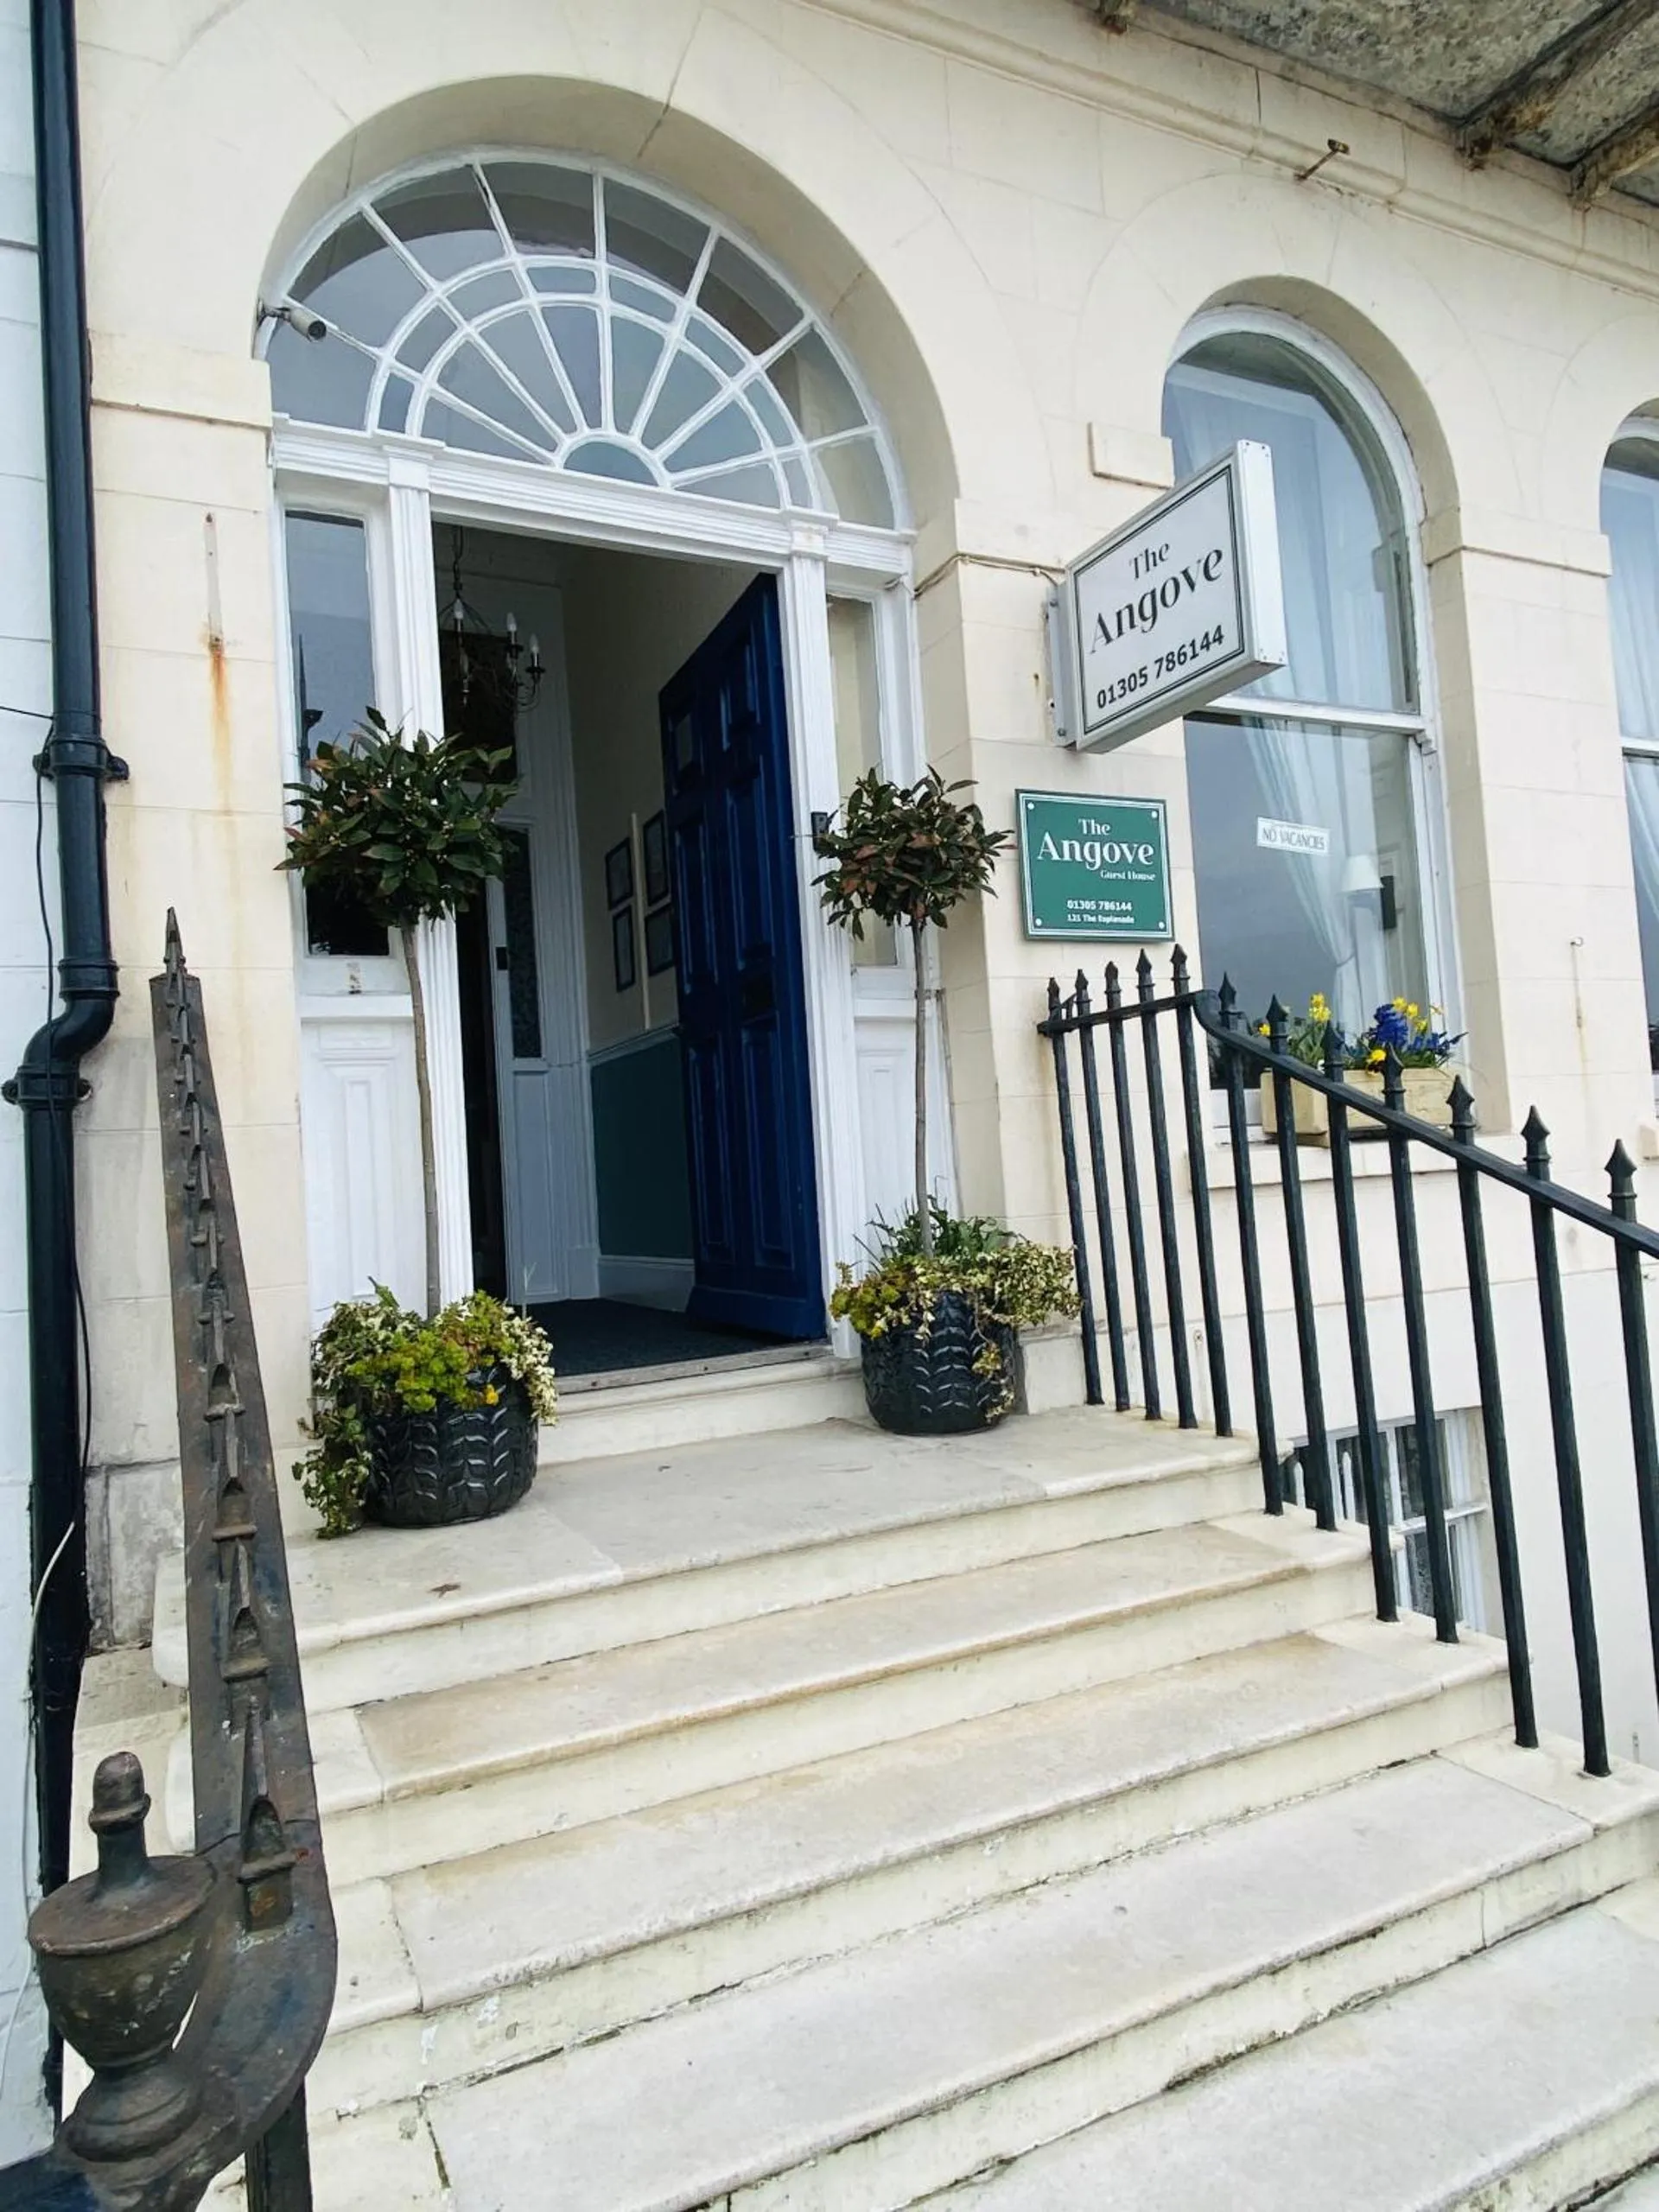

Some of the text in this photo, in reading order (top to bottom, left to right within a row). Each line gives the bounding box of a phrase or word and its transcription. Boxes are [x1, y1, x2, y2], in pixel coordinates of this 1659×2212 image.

[1129, 543, 1170, 580] The
[1090, 549, 1224, 654] Angove
[1096, 625, 1224, 709] 01305 786144
[1078, 818, 1110, 836] The
[1262, 828, 1325, 850] NO VACANCIES
[1038, 831, 1154, 871] Angove
[1100, 869, 1156, 881] Guest House
[1067, 899, 1133, 911] 01305 786144
[1083, 914, 1096, 923] The
